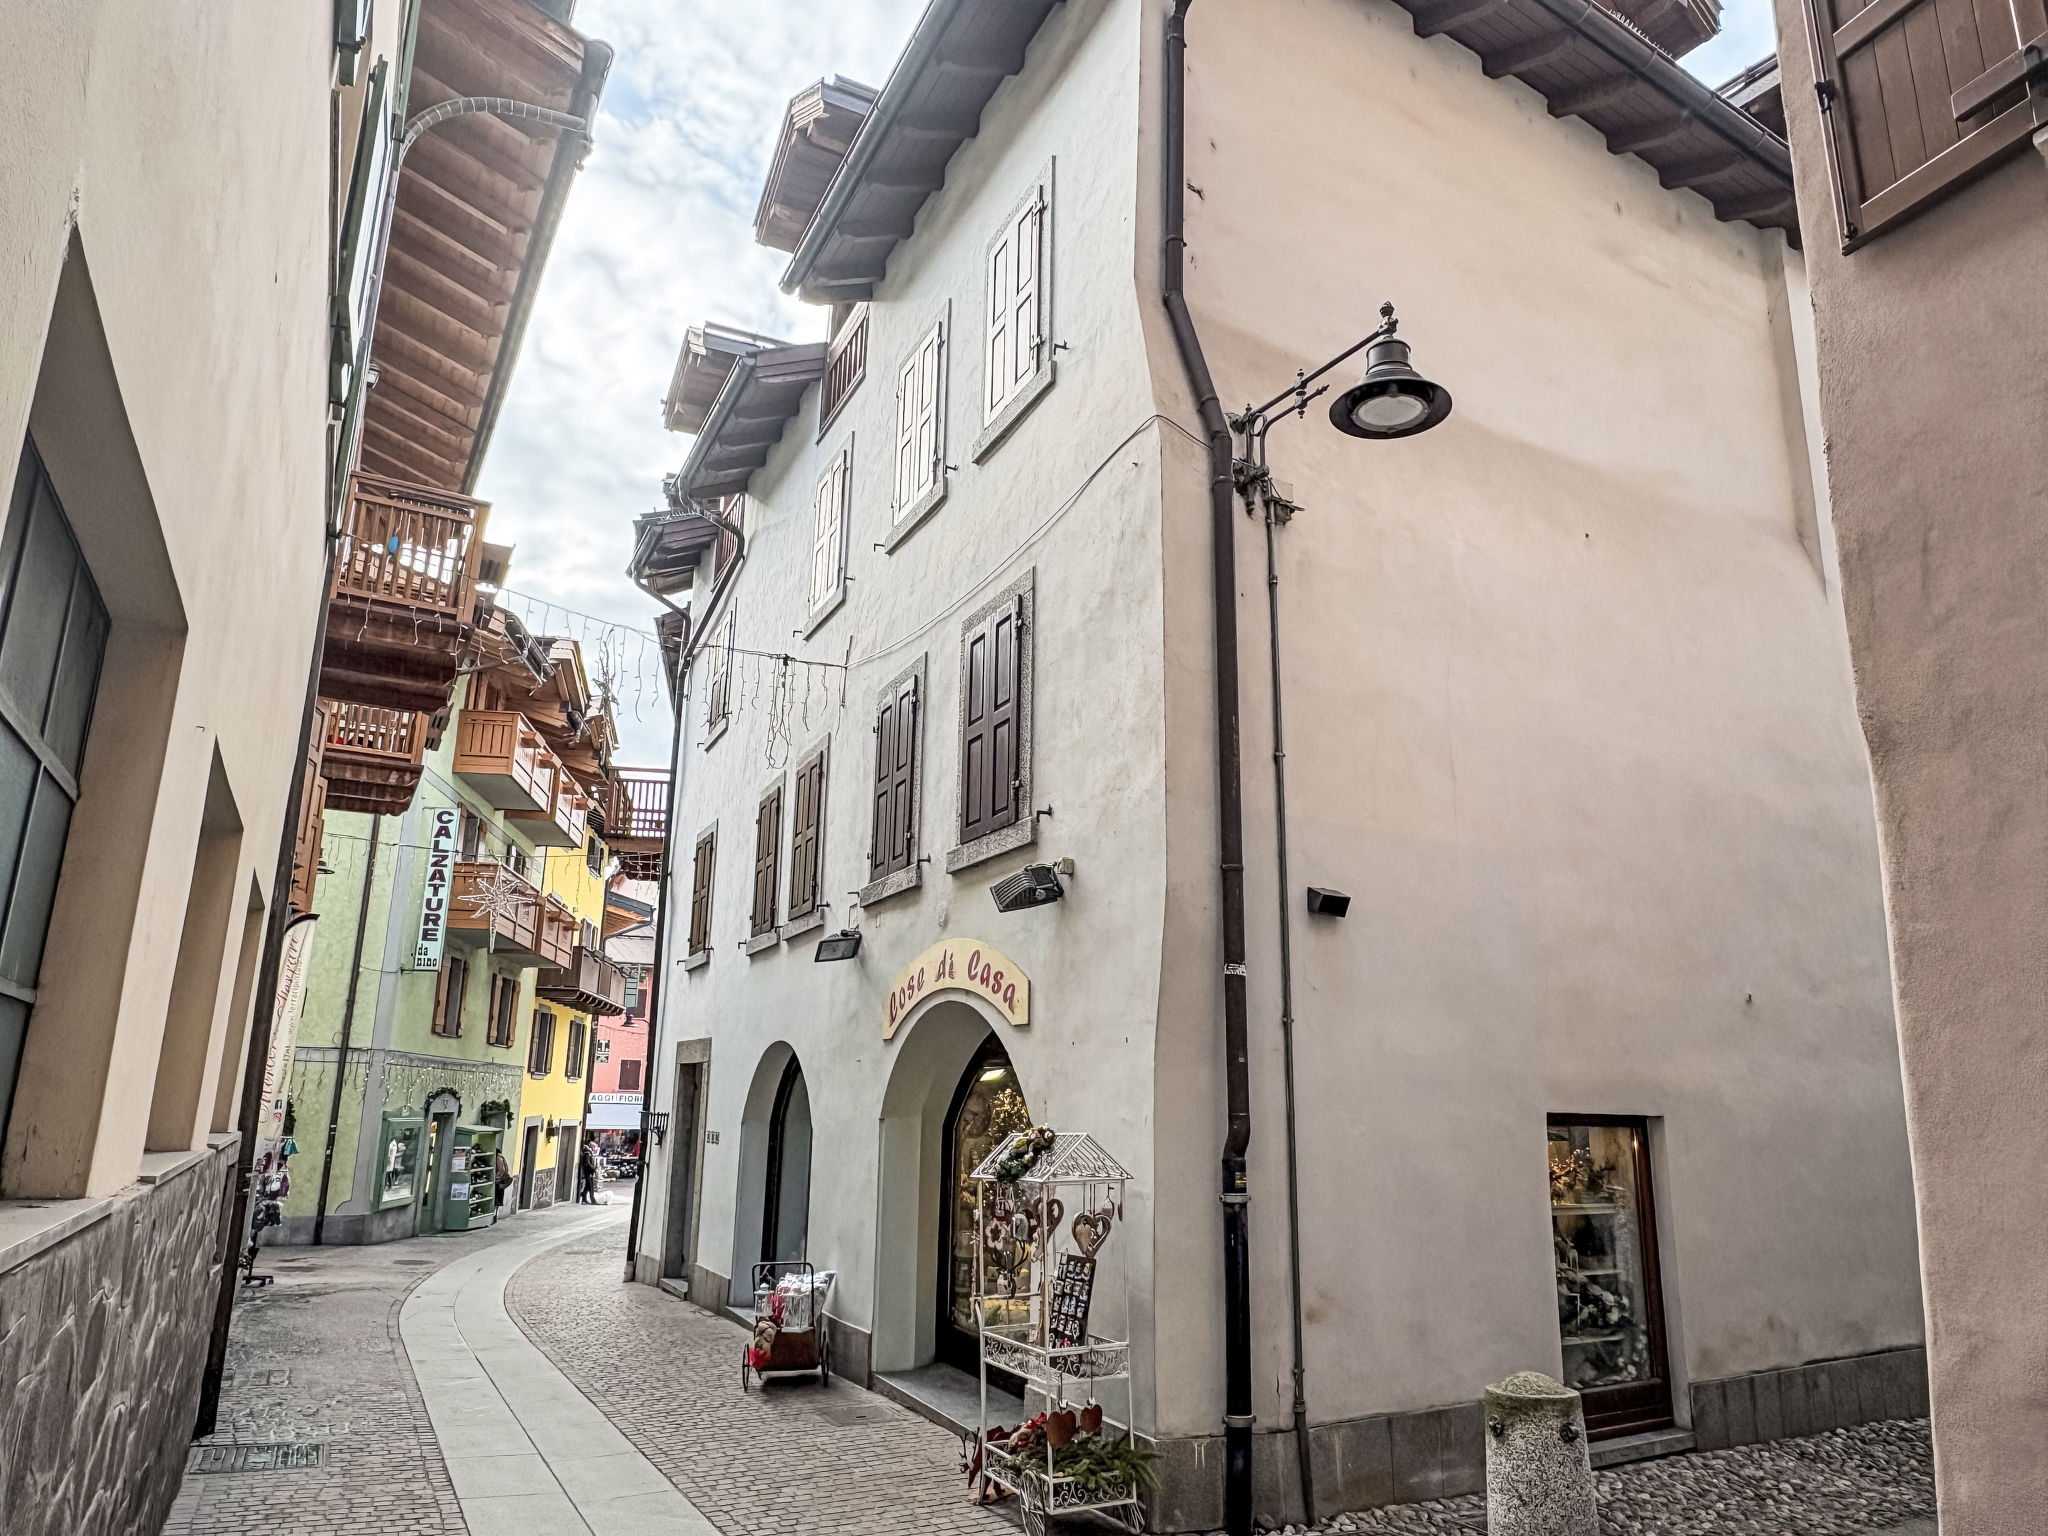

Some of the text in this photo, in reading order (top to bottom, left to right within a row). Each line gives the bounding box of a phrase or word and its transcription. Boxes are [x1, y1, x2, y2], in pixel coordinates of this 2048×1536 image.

[421, 811, 455, 941] CALZATURE
[418, 943, 428, 956] da
[889, 949, 1016, 1027] Cose di Casa
